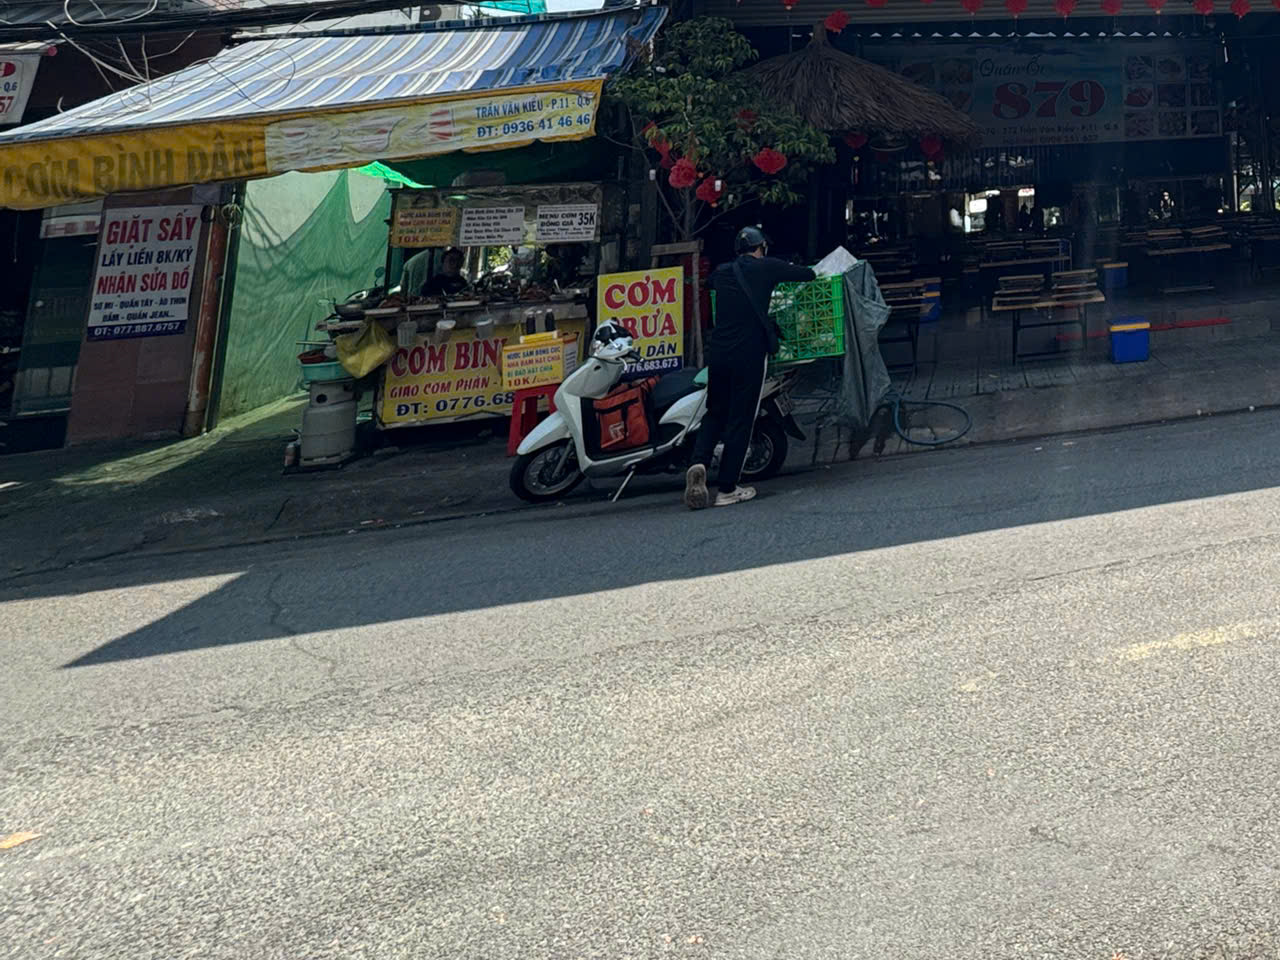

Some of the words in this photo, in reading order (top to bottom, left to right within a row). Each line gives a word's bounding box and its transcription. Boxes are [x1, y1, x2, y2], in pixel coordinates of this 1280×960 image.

[476, 101, 500, 119] TRẦN
[502, 99, 520, 116] VĂN
[522, 94, 543, 113] KIỂU
[551, 97, 569, 110] P.11
[992, 80, 1105, 120] 879
[477, 125, 498, 138] ĐT:
[503, 120, 535, 135] 0936
[538, 118, 553, 130] 41
[558, 116, 573, 127] 46
[576, 113, 590, 125] 46
[3, 154, 80, 198] CƠM
[93, 143, 175, 194] BÌNH
[187, 132, 254, 182] DÂN
[106, 215, 153, 249] GIẶT
[157, 208, 197, 242] SẤY
[578, 211, 596, 226] 35K
[101, 248, 124, 267] LẤY
[96, 270, 137, 297] NHẬN
[140, 267, 168, 292] SỬA
[171, 265, 191, 290] ĐỒ
[605, 275, 677, 309] CƠM
[616, 308, 677, 339] RƯA
[391, 340, 447, 377] CƠM
[454, 334, 508, 370] BÌN
[646, 340, 677, 357] DÂN
[625, 357, 678, 373] 776.683.673
[390, 384, 419, 398] GIAO
[396, 402, 428, 416] ĐT:
